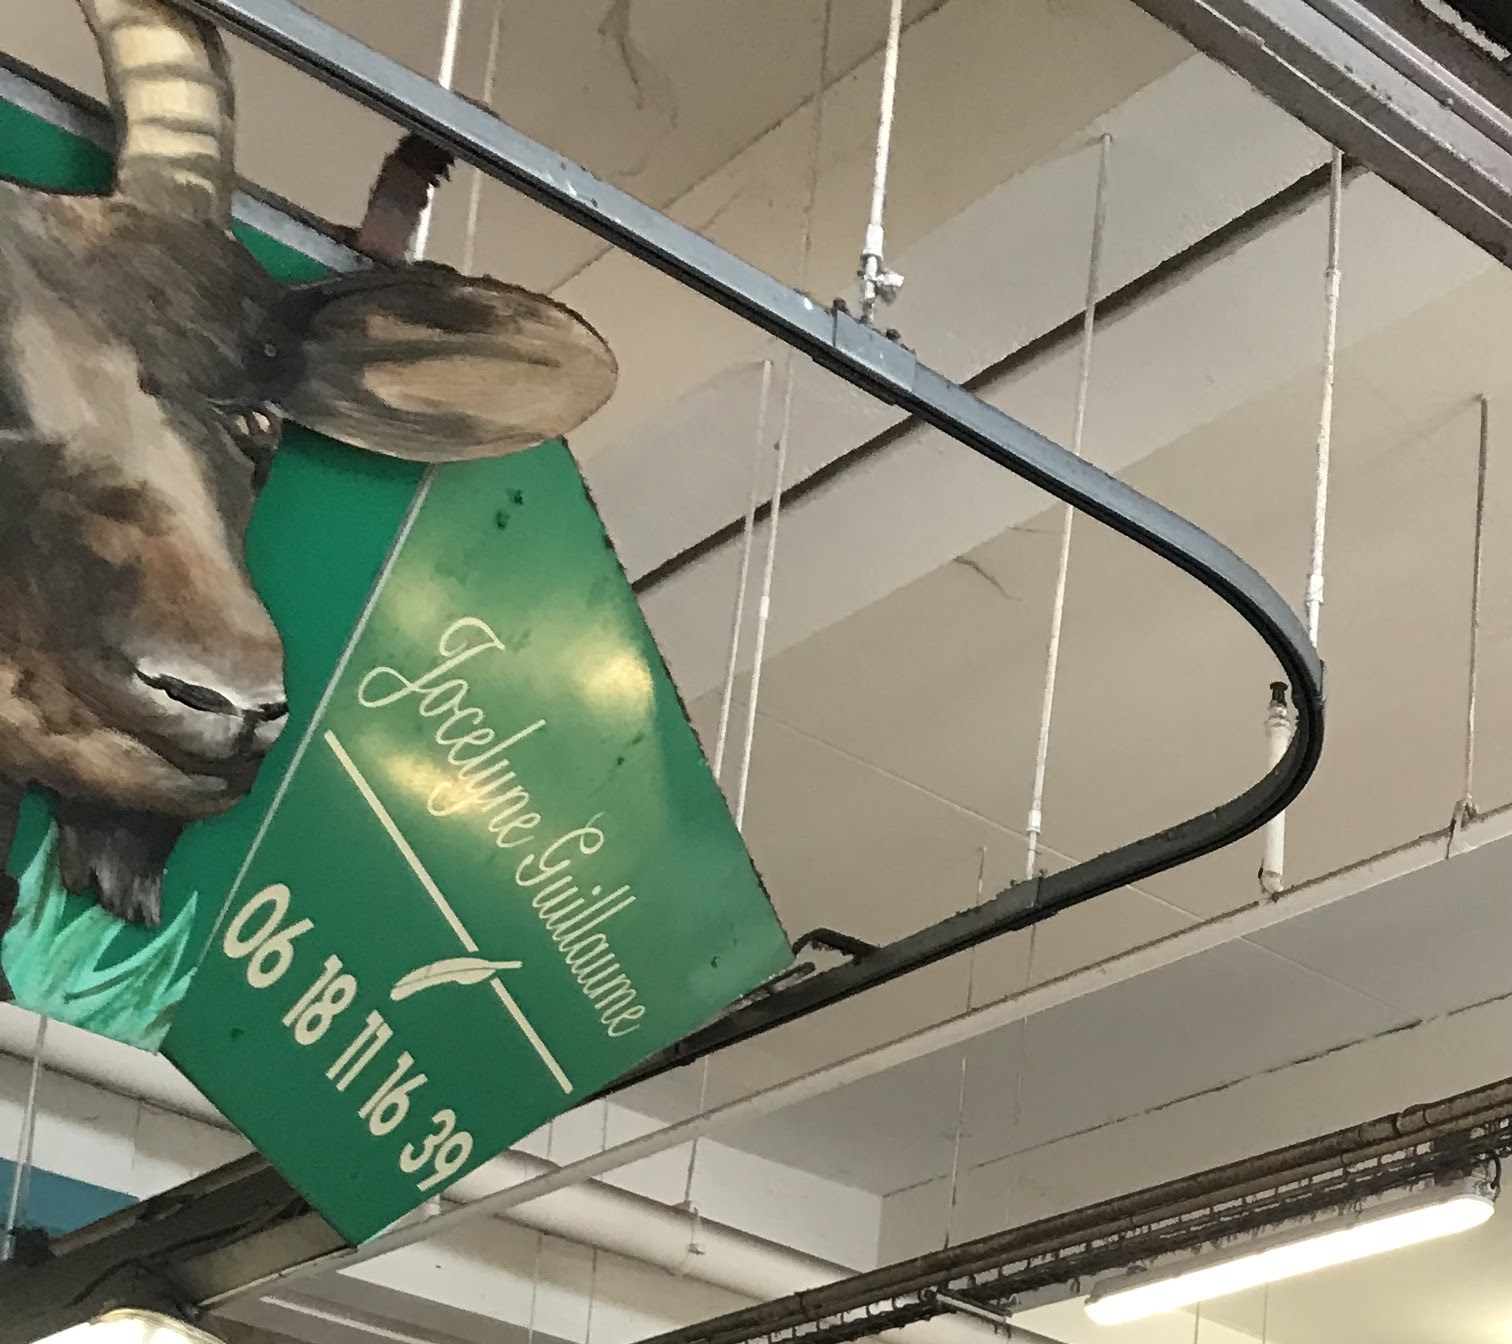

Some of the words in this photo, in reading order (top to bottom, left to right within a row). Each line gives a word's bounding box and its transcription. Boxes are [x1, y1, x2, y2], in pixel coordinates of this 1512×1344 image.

[358, 616, 547, 849] Jocelyne
[515, 812, 647, 1038] Guillaume
[223, 883, 315, 989] 06
[282, 954, 357, 1046] 18
[325, 1009, 394, 1092] 11
[358, 1051, 428, 1136] 16
[400, 1109, 474, 1192] 39
